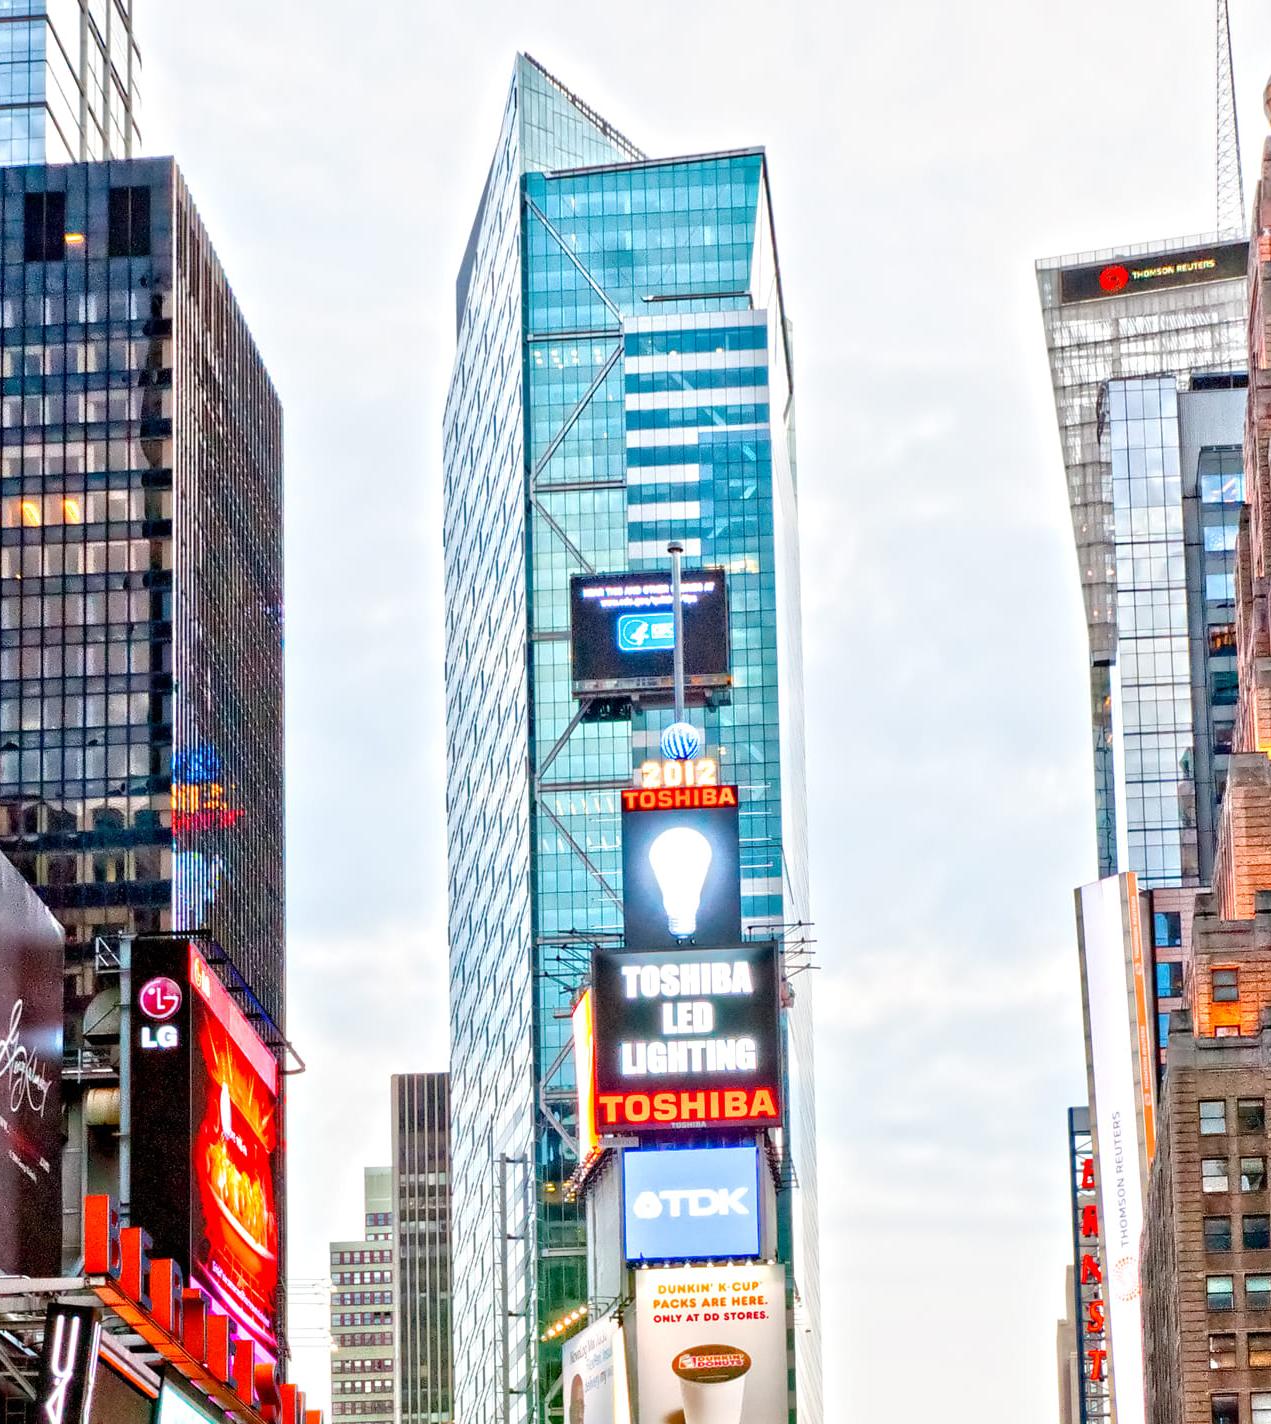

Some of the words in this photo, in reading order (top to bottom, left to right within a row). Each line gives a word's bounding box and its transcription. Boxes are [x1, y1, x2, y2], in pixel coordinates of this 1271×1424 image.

[1132, 266, 1174, 280] THOMSON
[1176, 259, 1216, 273] REUTERS
[641, 760, 718, 787] 2012
[623, 787, 736, 810] TOSHIBA
[622, 961, 754, 998] TOSHIBA
[661, 1002, 715, 1035] LED
[140, 1025, 180, 1049] LG
[622, 1038, 758, 1076] LIGHTING
[598, 1089, 778, 1123] TOSHIBA
[1111, 1110, 1124, 1170] REUTERS
[668, 1186, 750, 1218] TDK
[1112, 1173, 1131, 1249] THOMSON
[657, 1284, 713, 1294] DUNKIN'
[718, 1282, 759, 1293] K-CUP
[653, 1298, 697, 1309] PACKS
[701, 1297, 727, 1307] ARE
[732, 1295, 768, 1306] HERE.
[653, 1314, 681, 1323] ONLY
[686, 1313, 699, 1322] AT
[704, 1313, 719, 1321] DD
[723, 1311, 769, 1321] STORES.
[697, 1354, 744, 1362] DUNKIN'
